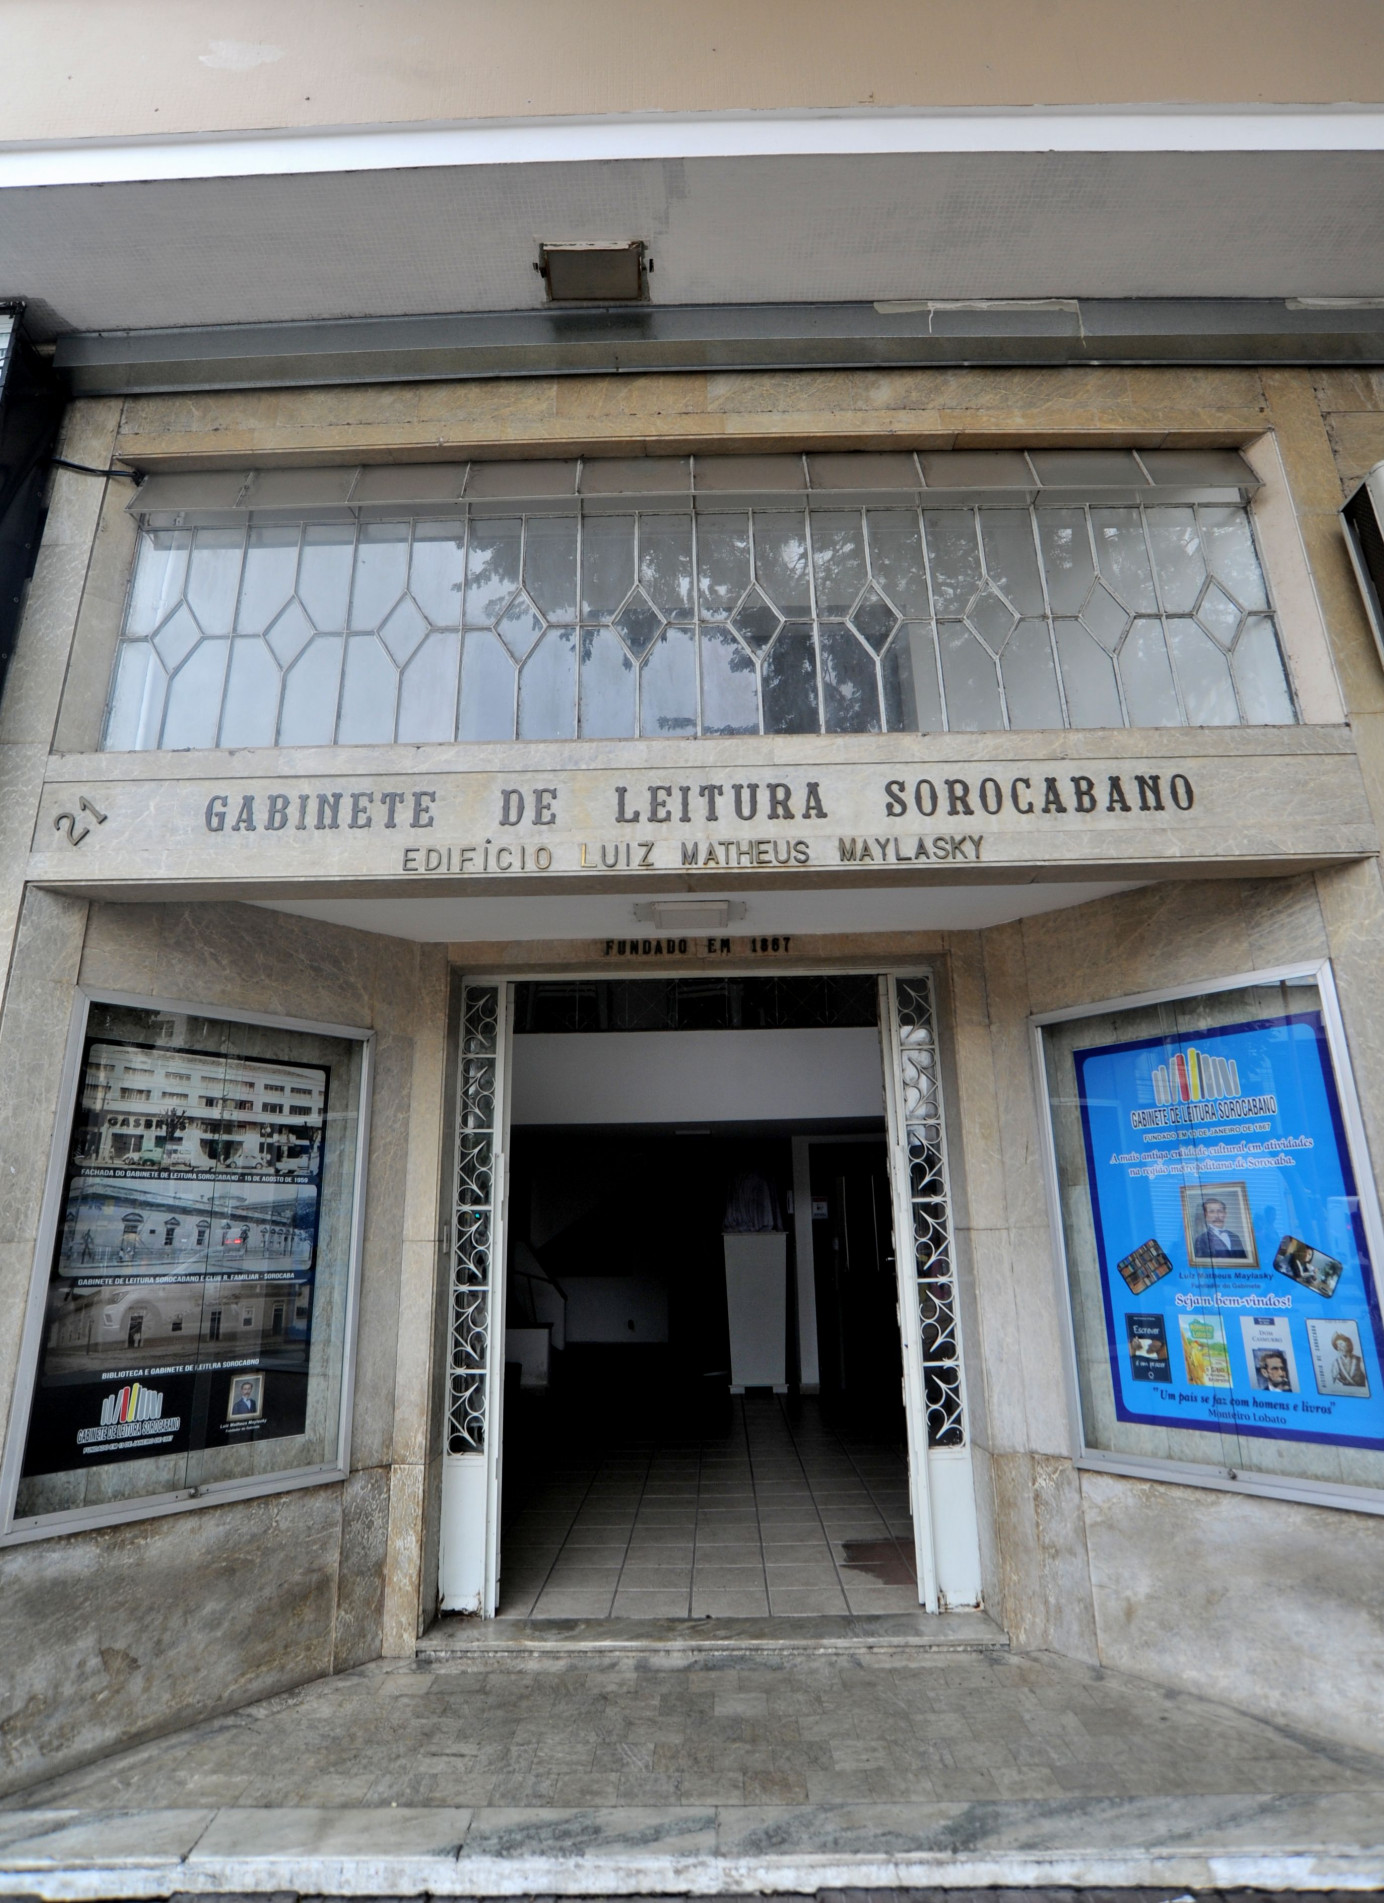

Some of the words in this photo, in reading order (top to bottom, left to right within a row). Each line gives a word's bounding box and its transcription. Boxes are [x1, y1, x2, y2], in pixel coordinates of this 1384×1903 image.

[205, 791, 436, 832] GABINETE
[499, 786, 558, 827] DE
[615, 780, 828, 824] LEITURA
[885, 773, 1196, 818] SOROCABANO
[53, 795, 108, 846] 21
[402, 838, 553, 874] EDIFÍCIO
[580, 840, 655, 871] LUIZ
[681, 838, 811, 866] MATHEUS
[838, 834, 985, 862] MAYLASKY
[605, 939, 688, 956] FUNDADO
[707, 937, 731, 954] EM
[751, 936, 792, 953] 1867
[1131, 1108, 1169, 1129] GABINETE
[1169, 1106, 1181, 1124] DE
[1181, 1102, 1217, 1123] LEITURA
[1217, 1096, 1277, 1119] SOROCABANO
[1143, 1132, 1177, 1142] FUNDADO
[1178, 1130, 1188, 1139] EM
[1198, 1127, 1209, 1137] DE
[1209, 1125, 1241, 1136] JANEIRO
[1241, 1123, 1253, 1133] DE
[1254, 1122, 1271, 1132] 1867
[1110, 1153, 1119, 1164] A
[1119, 1151, 1140, 1163] mais
[1141, 1149, 1169, 1165] antiga
[1209, 1140, 1247, 1155] cultural
[1247, 1142, 1262, 1153] em
[1263, 1135, 1314, 1151] atividades
[1129, 1167, 1140, 1177] na
[1235, 1156, 1246, 1169] de
[1247, 1153, 1295, 1168] Sorocaba.
[81, 1168, 114, 1177] FACHADA
[115, 1169, 125, 1177] DO
[126, 1169, 158, 1178] GABINETE
[160, 1171, 169, 1179] DE
[170, 1171, 197, 1180] LEITURA
[261, 1175, 284, 1183] AGOSTO
[78, 1277, 113, 1287] GABINETE
[114, 1276, 124, 1285] DE
[125, 1276, 154, 1285] LEITURA
[155, 1274, 200, 1283] SOROCABANO
[230, 1273, 259, 1281] FAMILIAR
[264, 1271, 295, 1280] SOROCABA
[1176, 1294, 1213, 1310] Sejam
[1214, 1292, 1292, 1308] bem-vindos!
[1133, 1324, 1160, 1335] Escrever
[102, 1368, 143, 1380] BIBLIOTECA
[144, 1368, 149, 1376] E
[151, 1365, 184, 1375] GABINETE
[185, 1364, 194, 1373] DE
[1201, 1396, 1210, 1404] se
[1230, 1397, 1250, 1407] com
[1252, 1396, 1290, 1411] homens
[1293, 1403, 1299, 1412] e
[1208, 1408, 1251, 1421] Monteiro
[1253, 1412, 1287, 1425] Lobato
